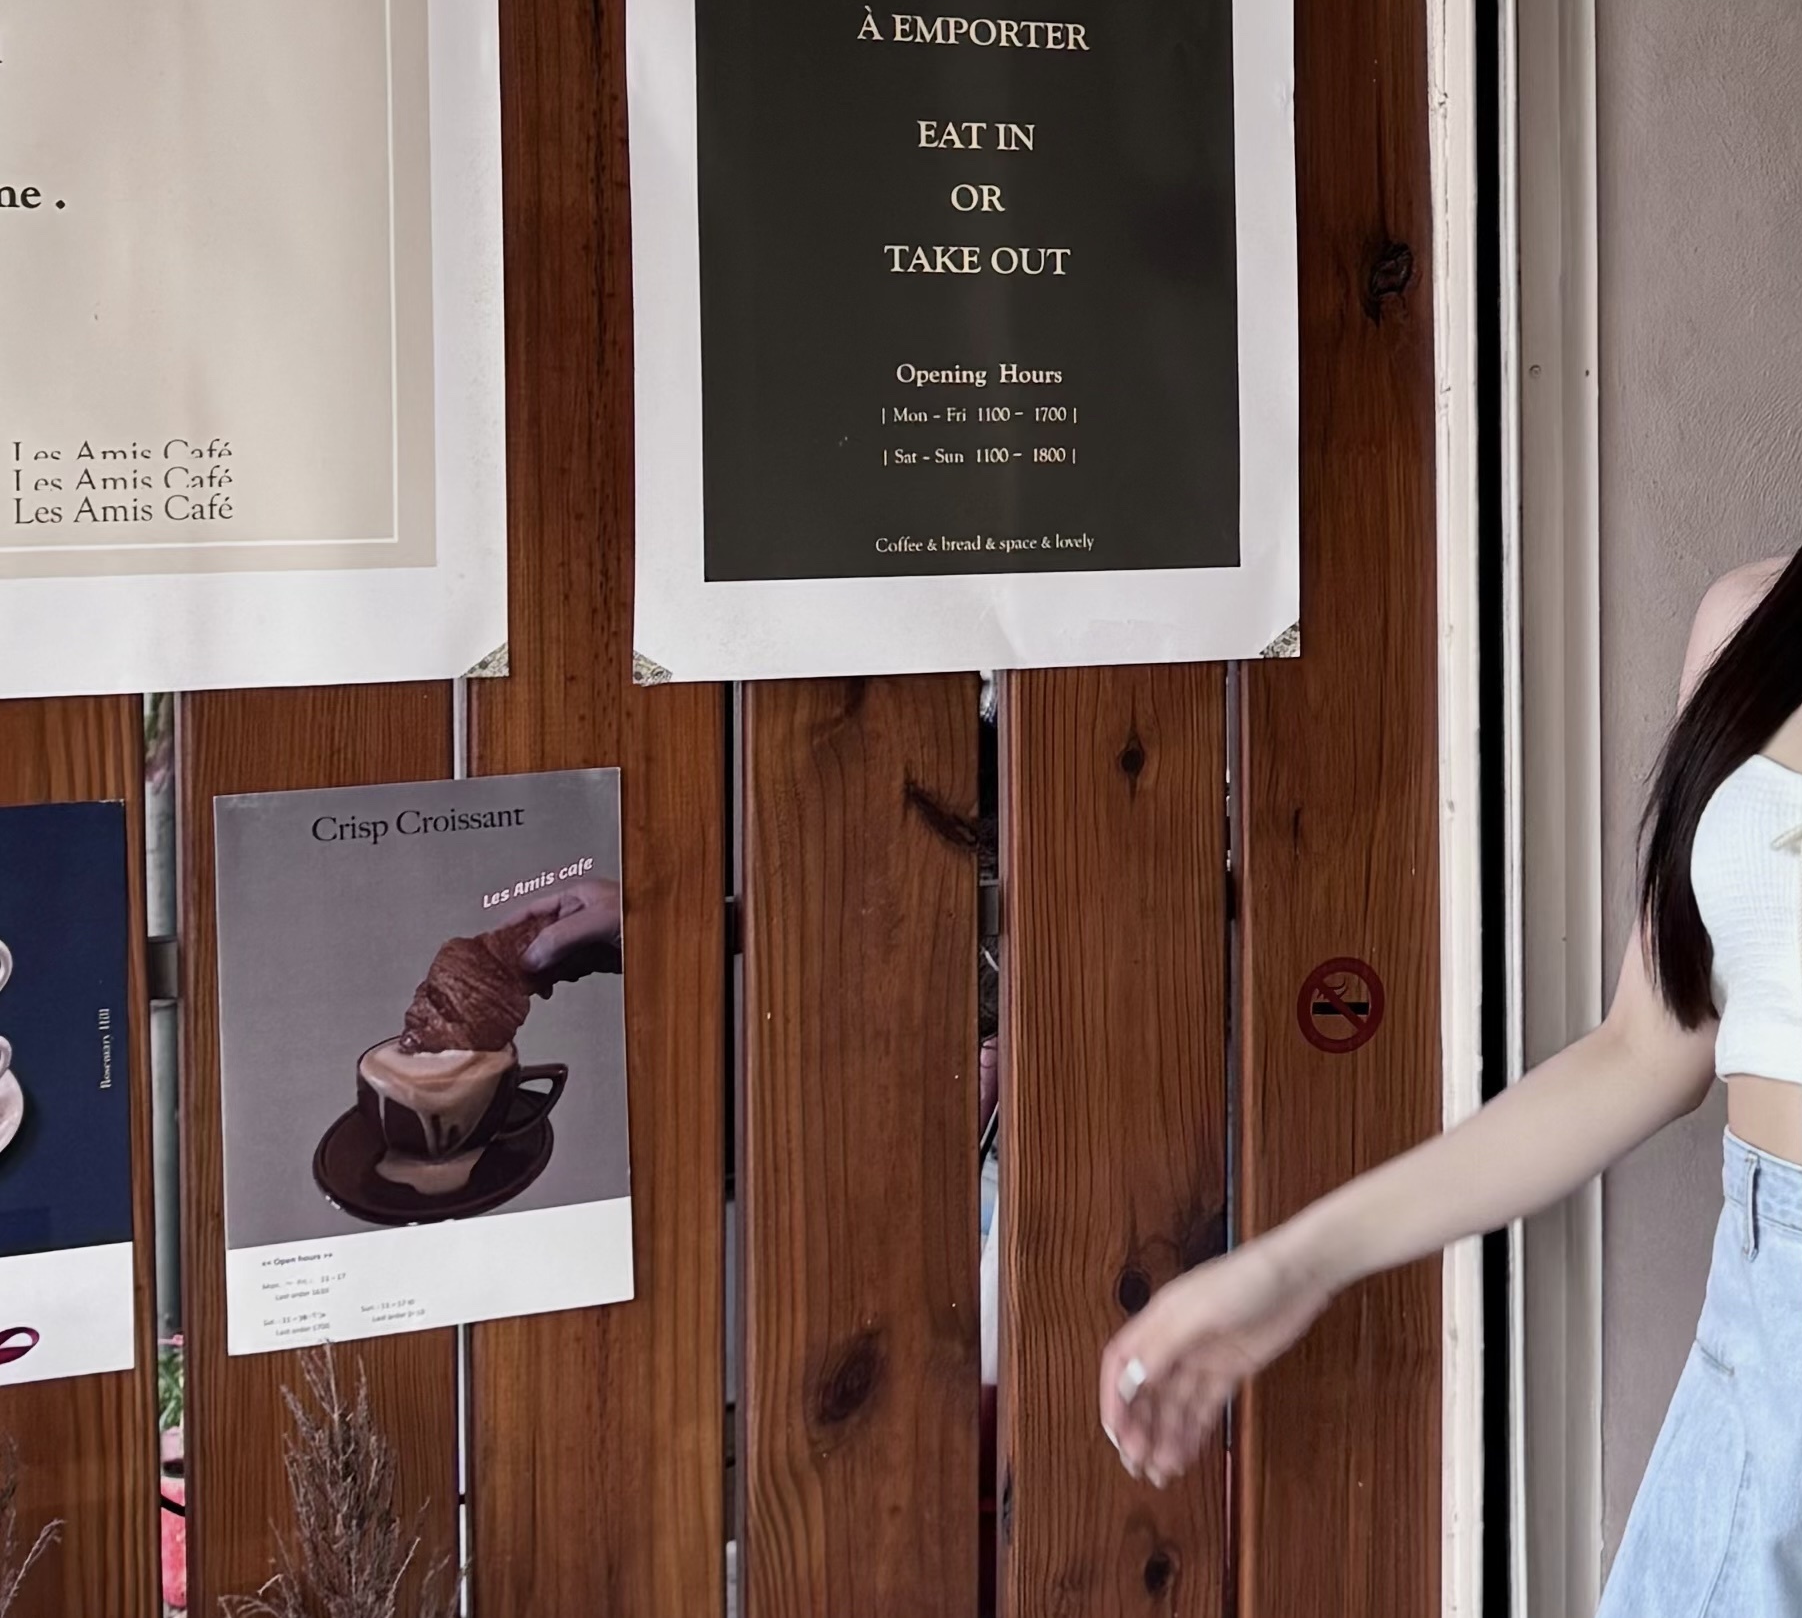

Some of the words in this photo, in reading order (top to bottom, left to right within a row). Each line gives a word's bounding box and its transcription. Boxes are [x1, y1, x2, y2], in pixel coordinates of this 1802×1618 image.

[857, 5, 884, 40] À
[892, 13, 1090, 51] EMPORTER
[917, 120, 987, 150] EAT
[995, 123, 1036, 151] IN
[951, 184, 1006, 212] OR
[884, 245, 982, 274] TAKE
[991, 247, 1071, 275] OUT
[896, 363, 987, 387] Opening
[999, 363, 1063, 384] Hours
[893, 407, 928, 423] Mon
[947, 407, 967, 422] Fri
[1035, 407, 1067, 422] 1700
[894, 448, 917, 464] Sat
[935, 448, 964, 464] Sun
[1033, 448, 1066, 463] 1800
[13, 498, 63, 524] Les
[73, 496, 153, 523] Amis
[164, 493, 233, 521] Café
[875, 536, 924, 553] Coffee
[927, 538, 938, 552] &
[942, 535, 981, 551] bread
[985, 537, 996, 551] &
[999, 538, 1037, 554] space
[1040, 536, 1051, 550] &
[1055, 533, 1095, 551] lovely
[311, 815, 389, 844] Crisp
[396, 808, 525, 835] Croissant
[483, 890, 510, 909] Les
[513, 871, 555, 897] Amis
[558, 856, 594, 881] cafe
